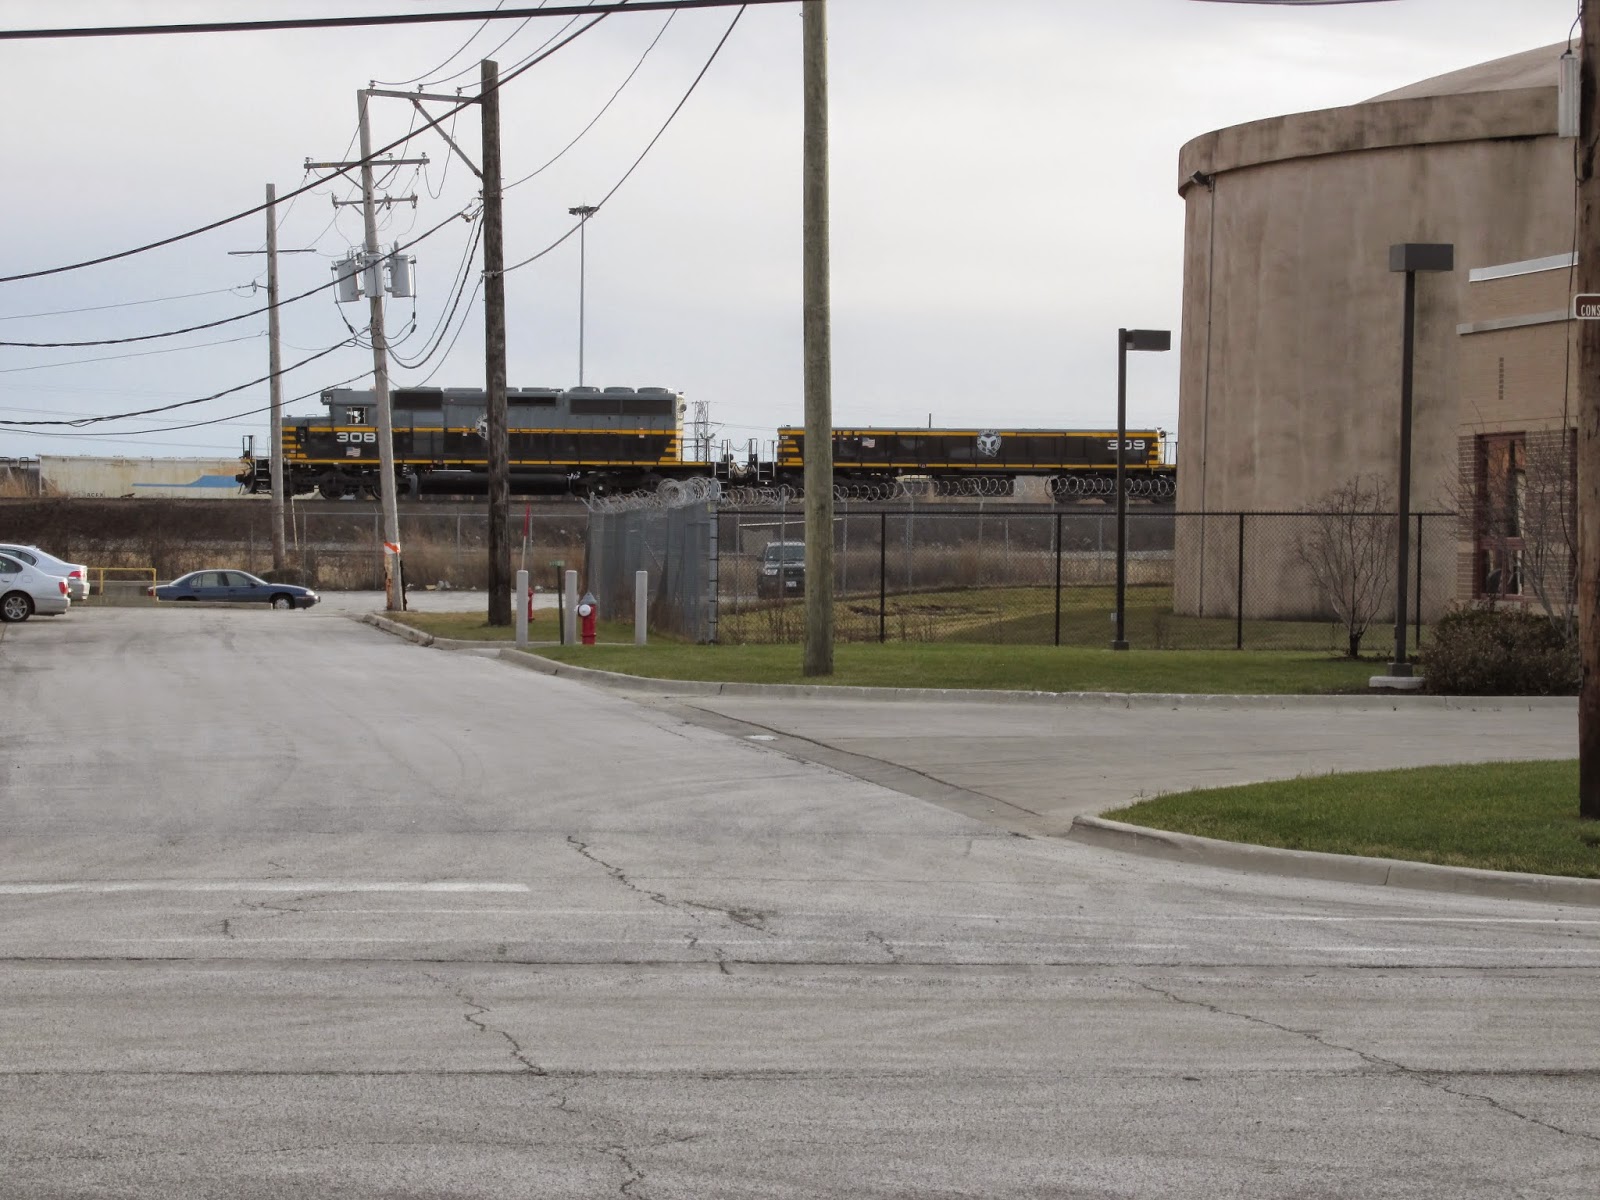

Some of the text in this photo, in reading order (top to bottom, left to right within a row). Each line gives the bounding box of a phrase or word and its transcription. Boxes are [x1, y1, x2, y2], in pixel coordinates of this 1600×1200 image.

[1581, 304, 1600, 316] CONS
[336, 432, 376, 442] 308
[1107, 440, 1146, 450] 309
